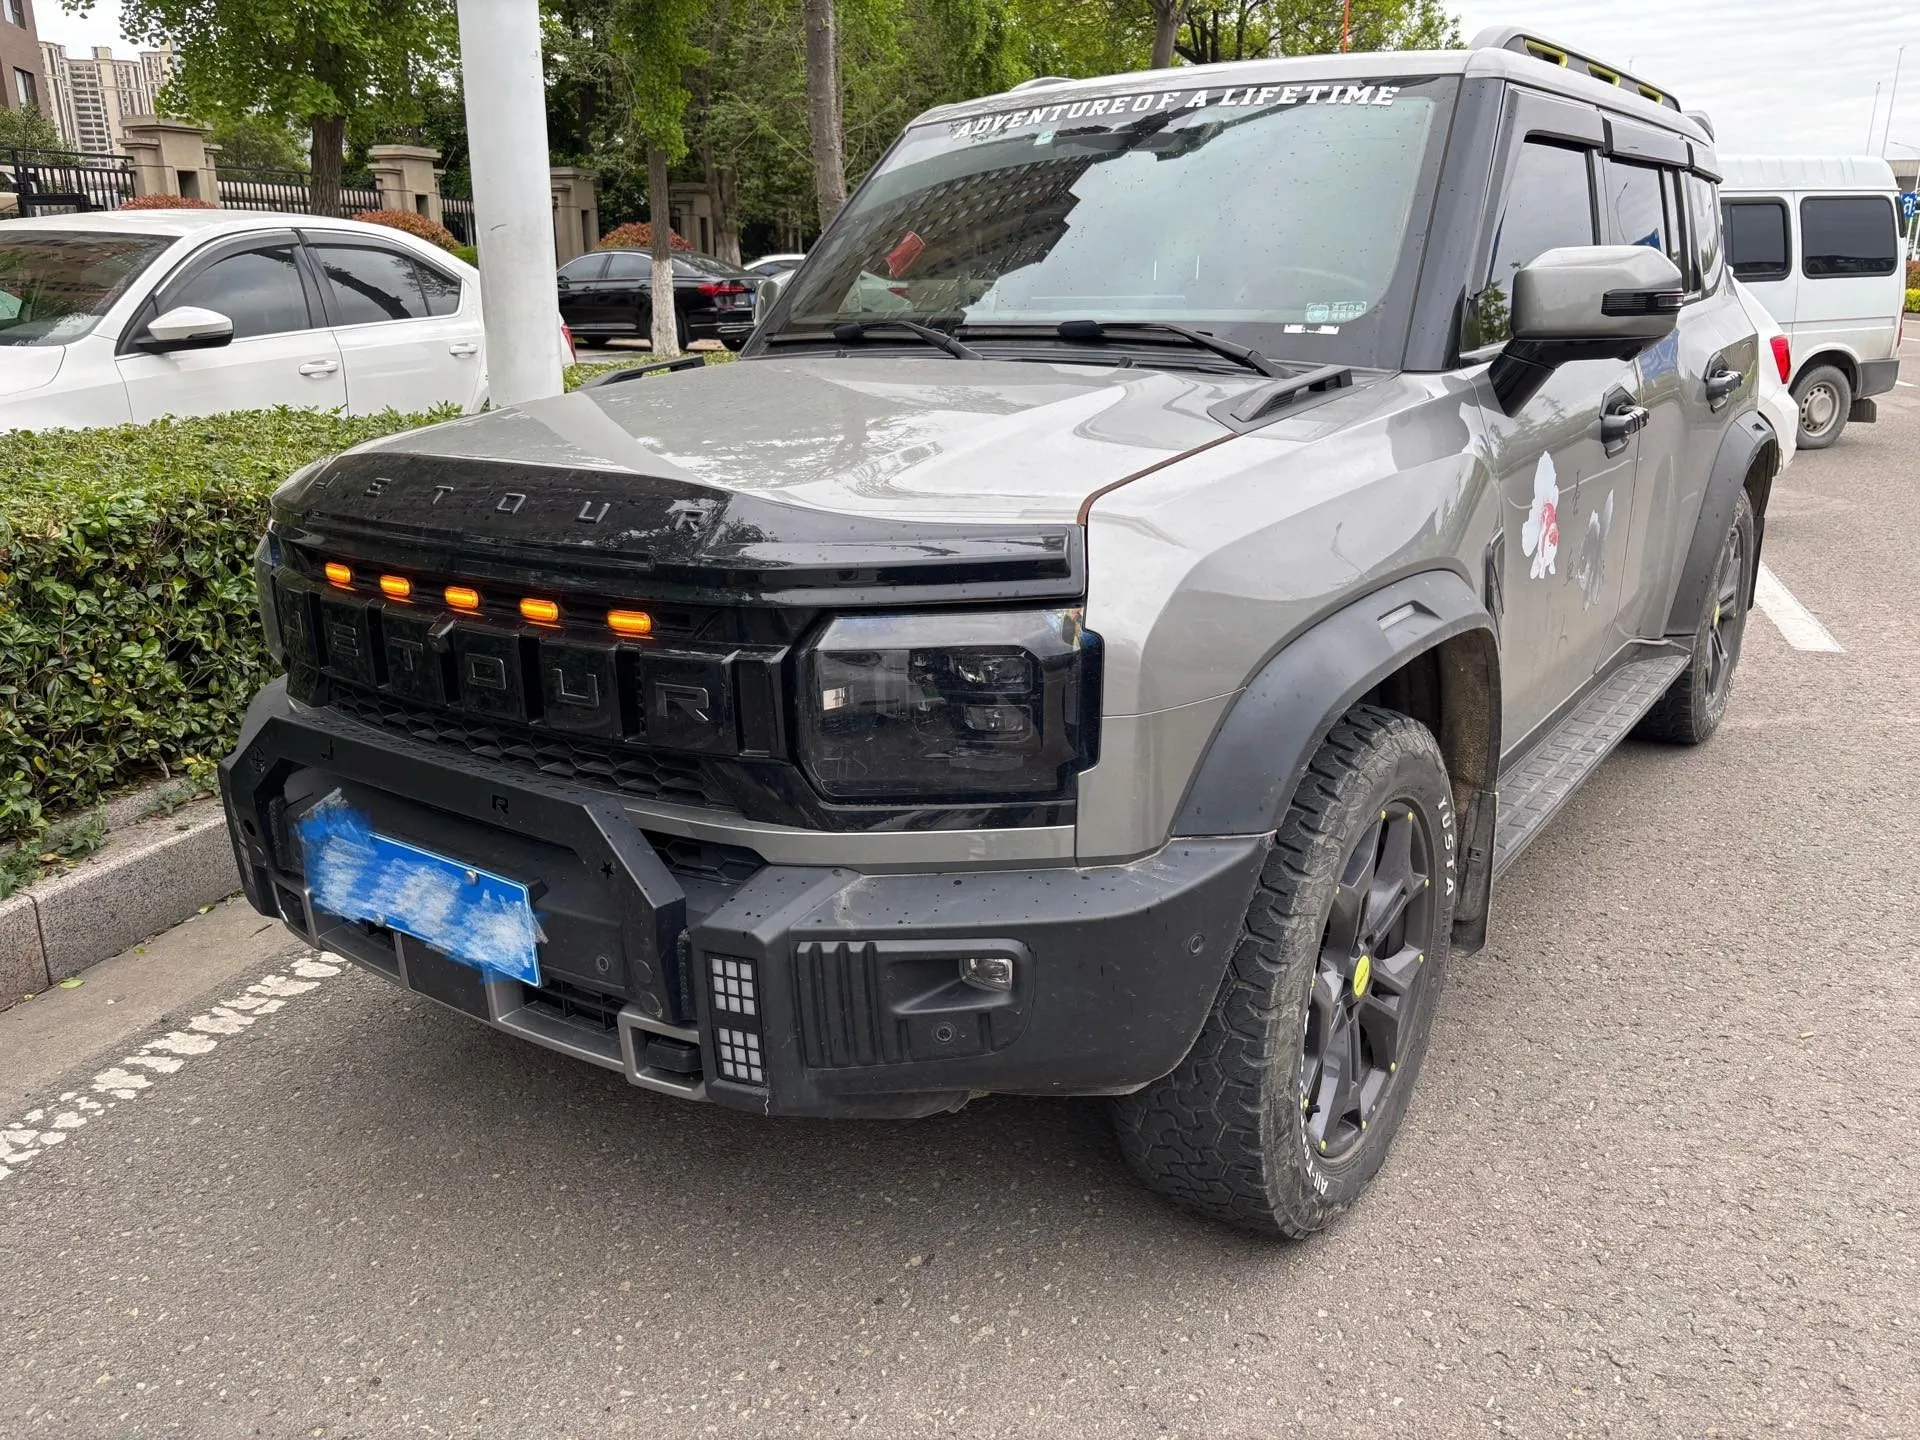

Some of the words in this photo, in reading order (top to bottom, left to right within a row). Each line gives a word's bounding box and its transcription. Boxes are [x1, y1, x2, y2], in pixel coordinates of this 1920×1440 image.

[1185, 89, 1208, 108] A
[1218, 85, 1401, 106] LIFETIME
[1438, 795, 1454, 896] YUSTA
